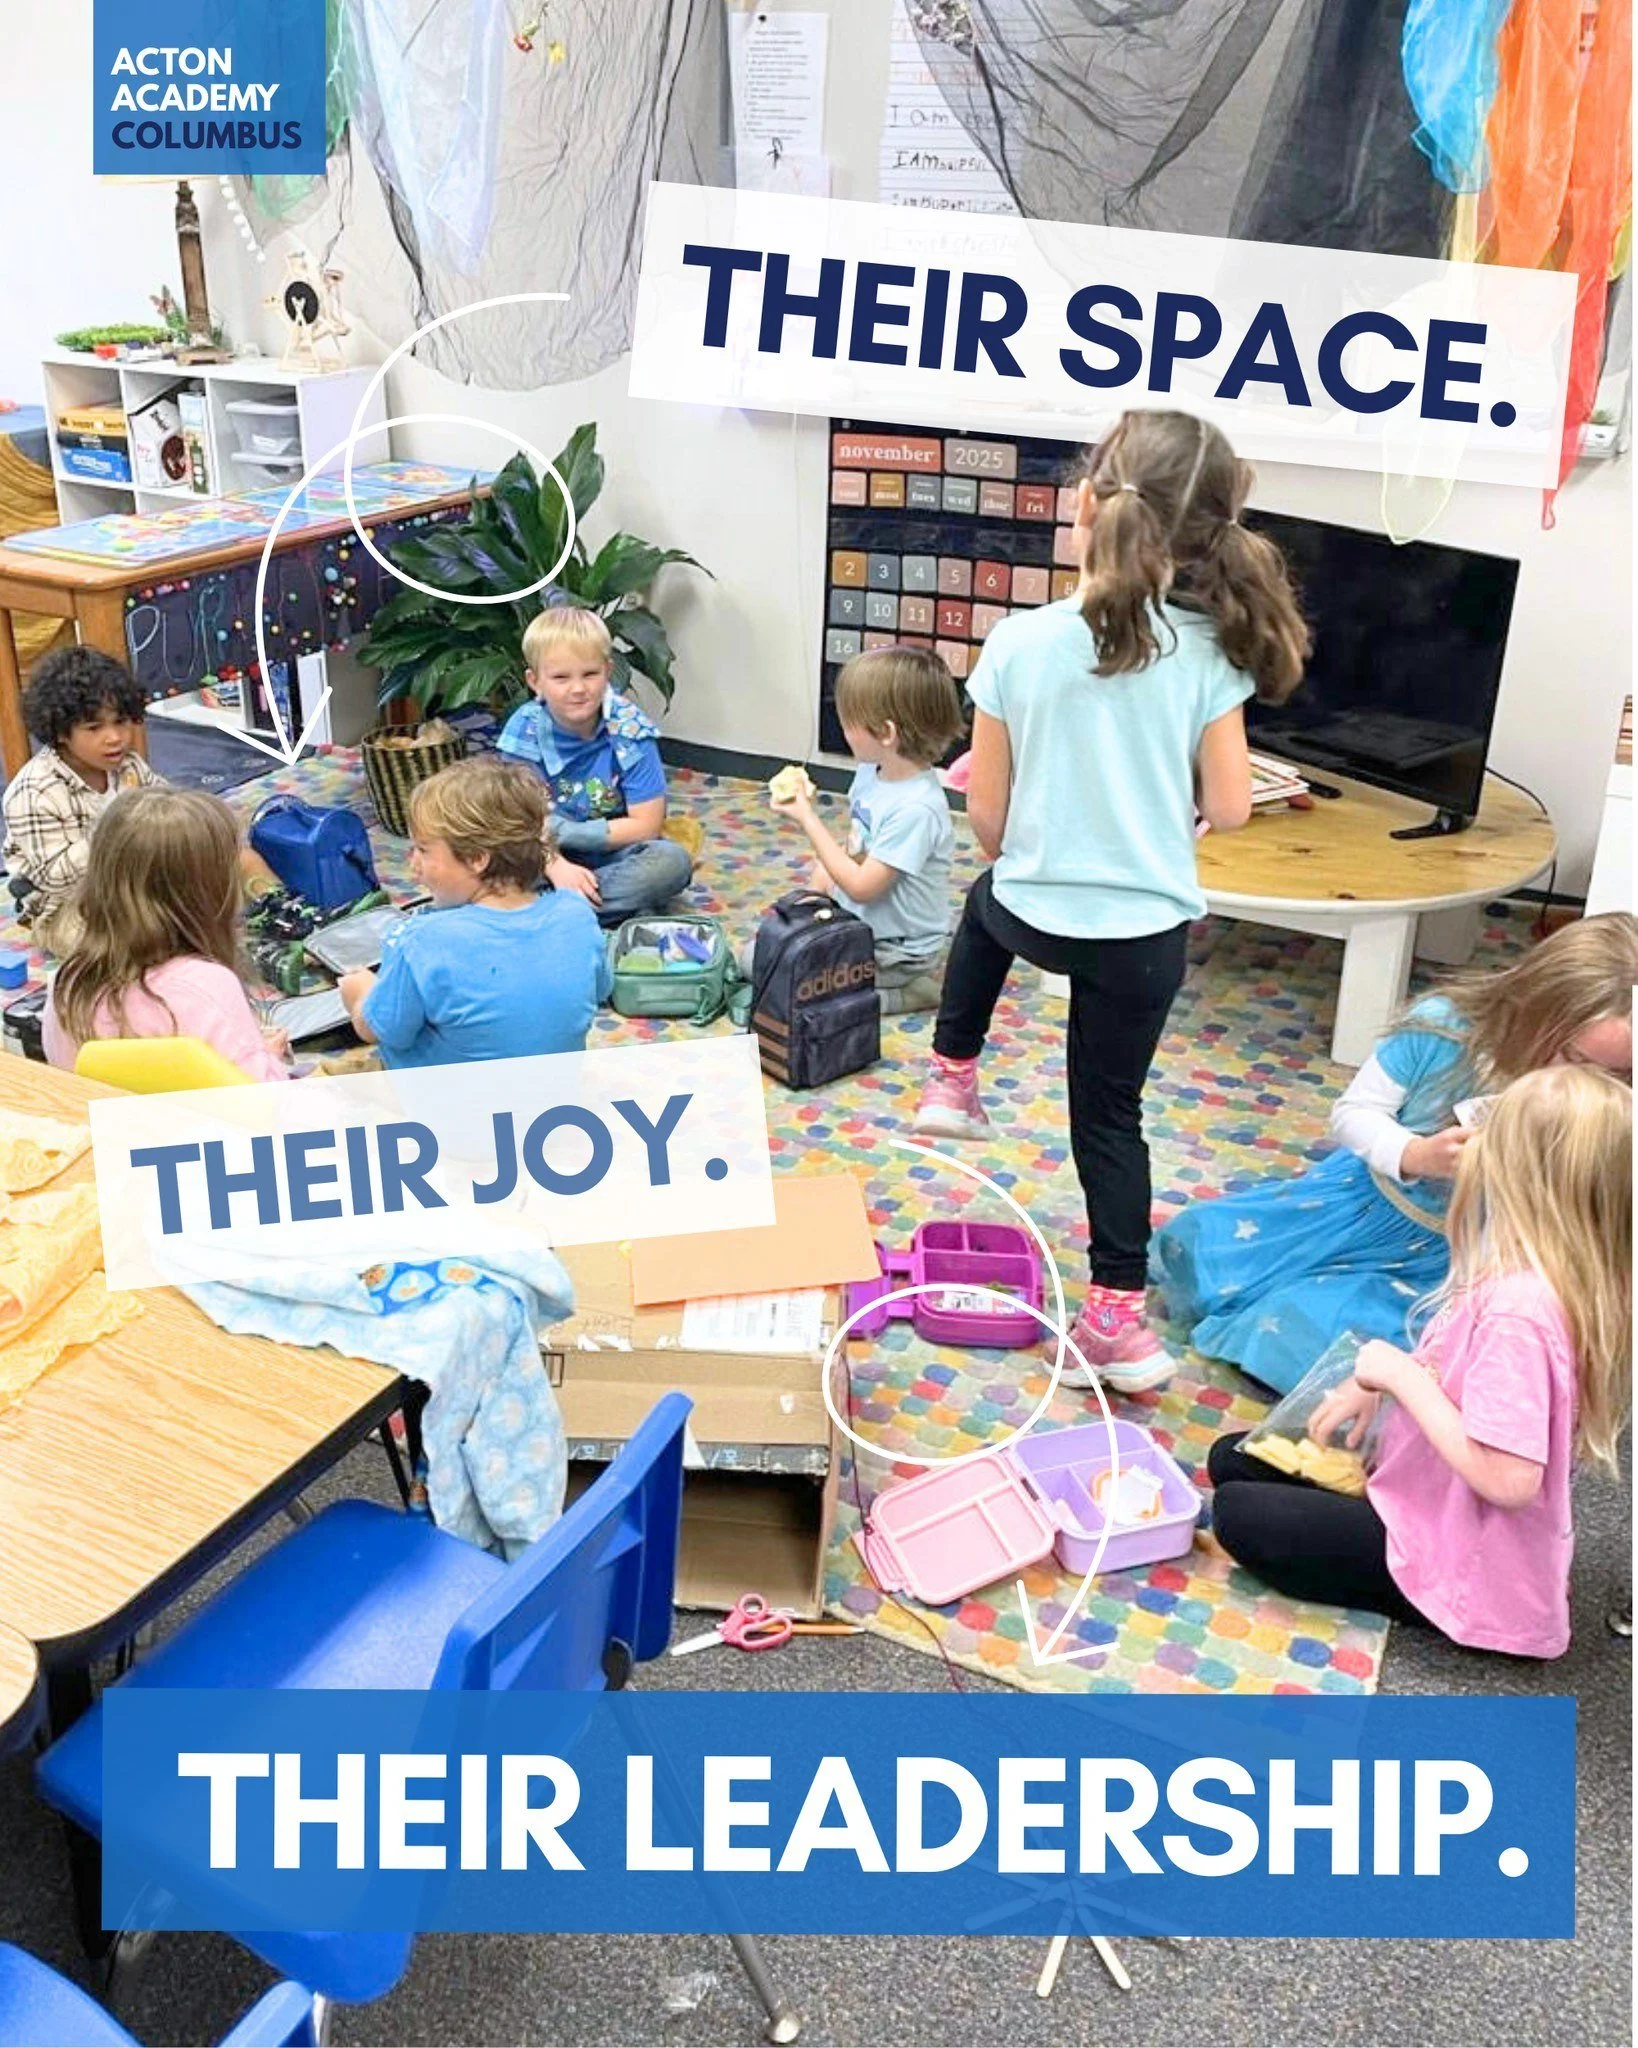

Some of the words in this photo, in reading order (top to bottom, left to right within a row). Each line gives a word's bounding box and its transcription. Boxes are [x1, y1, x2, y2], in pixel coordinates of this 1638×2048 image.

[841, 445, 935, 462] november
[955, 447, 1003, 468] 2025
[1025, 501, 1044, 513] fri
[845, 561, 856, 576] 2
[879, 564, 889, 579] 3
[914, 567, 925, 580] 4
[951, 570, 960, 585] 5
[986, 574, 997, 588] 6
[1025, 578, 1036, 592] 7
[843, 600, 853, 613] 9
[873, 604, 892, 618] 10
[908, 608, 925, 623] 11
[945, 612, 964, 627] 12
[834, 640, 853, 654] 16
[797, 962, 876, 1001] adidas
